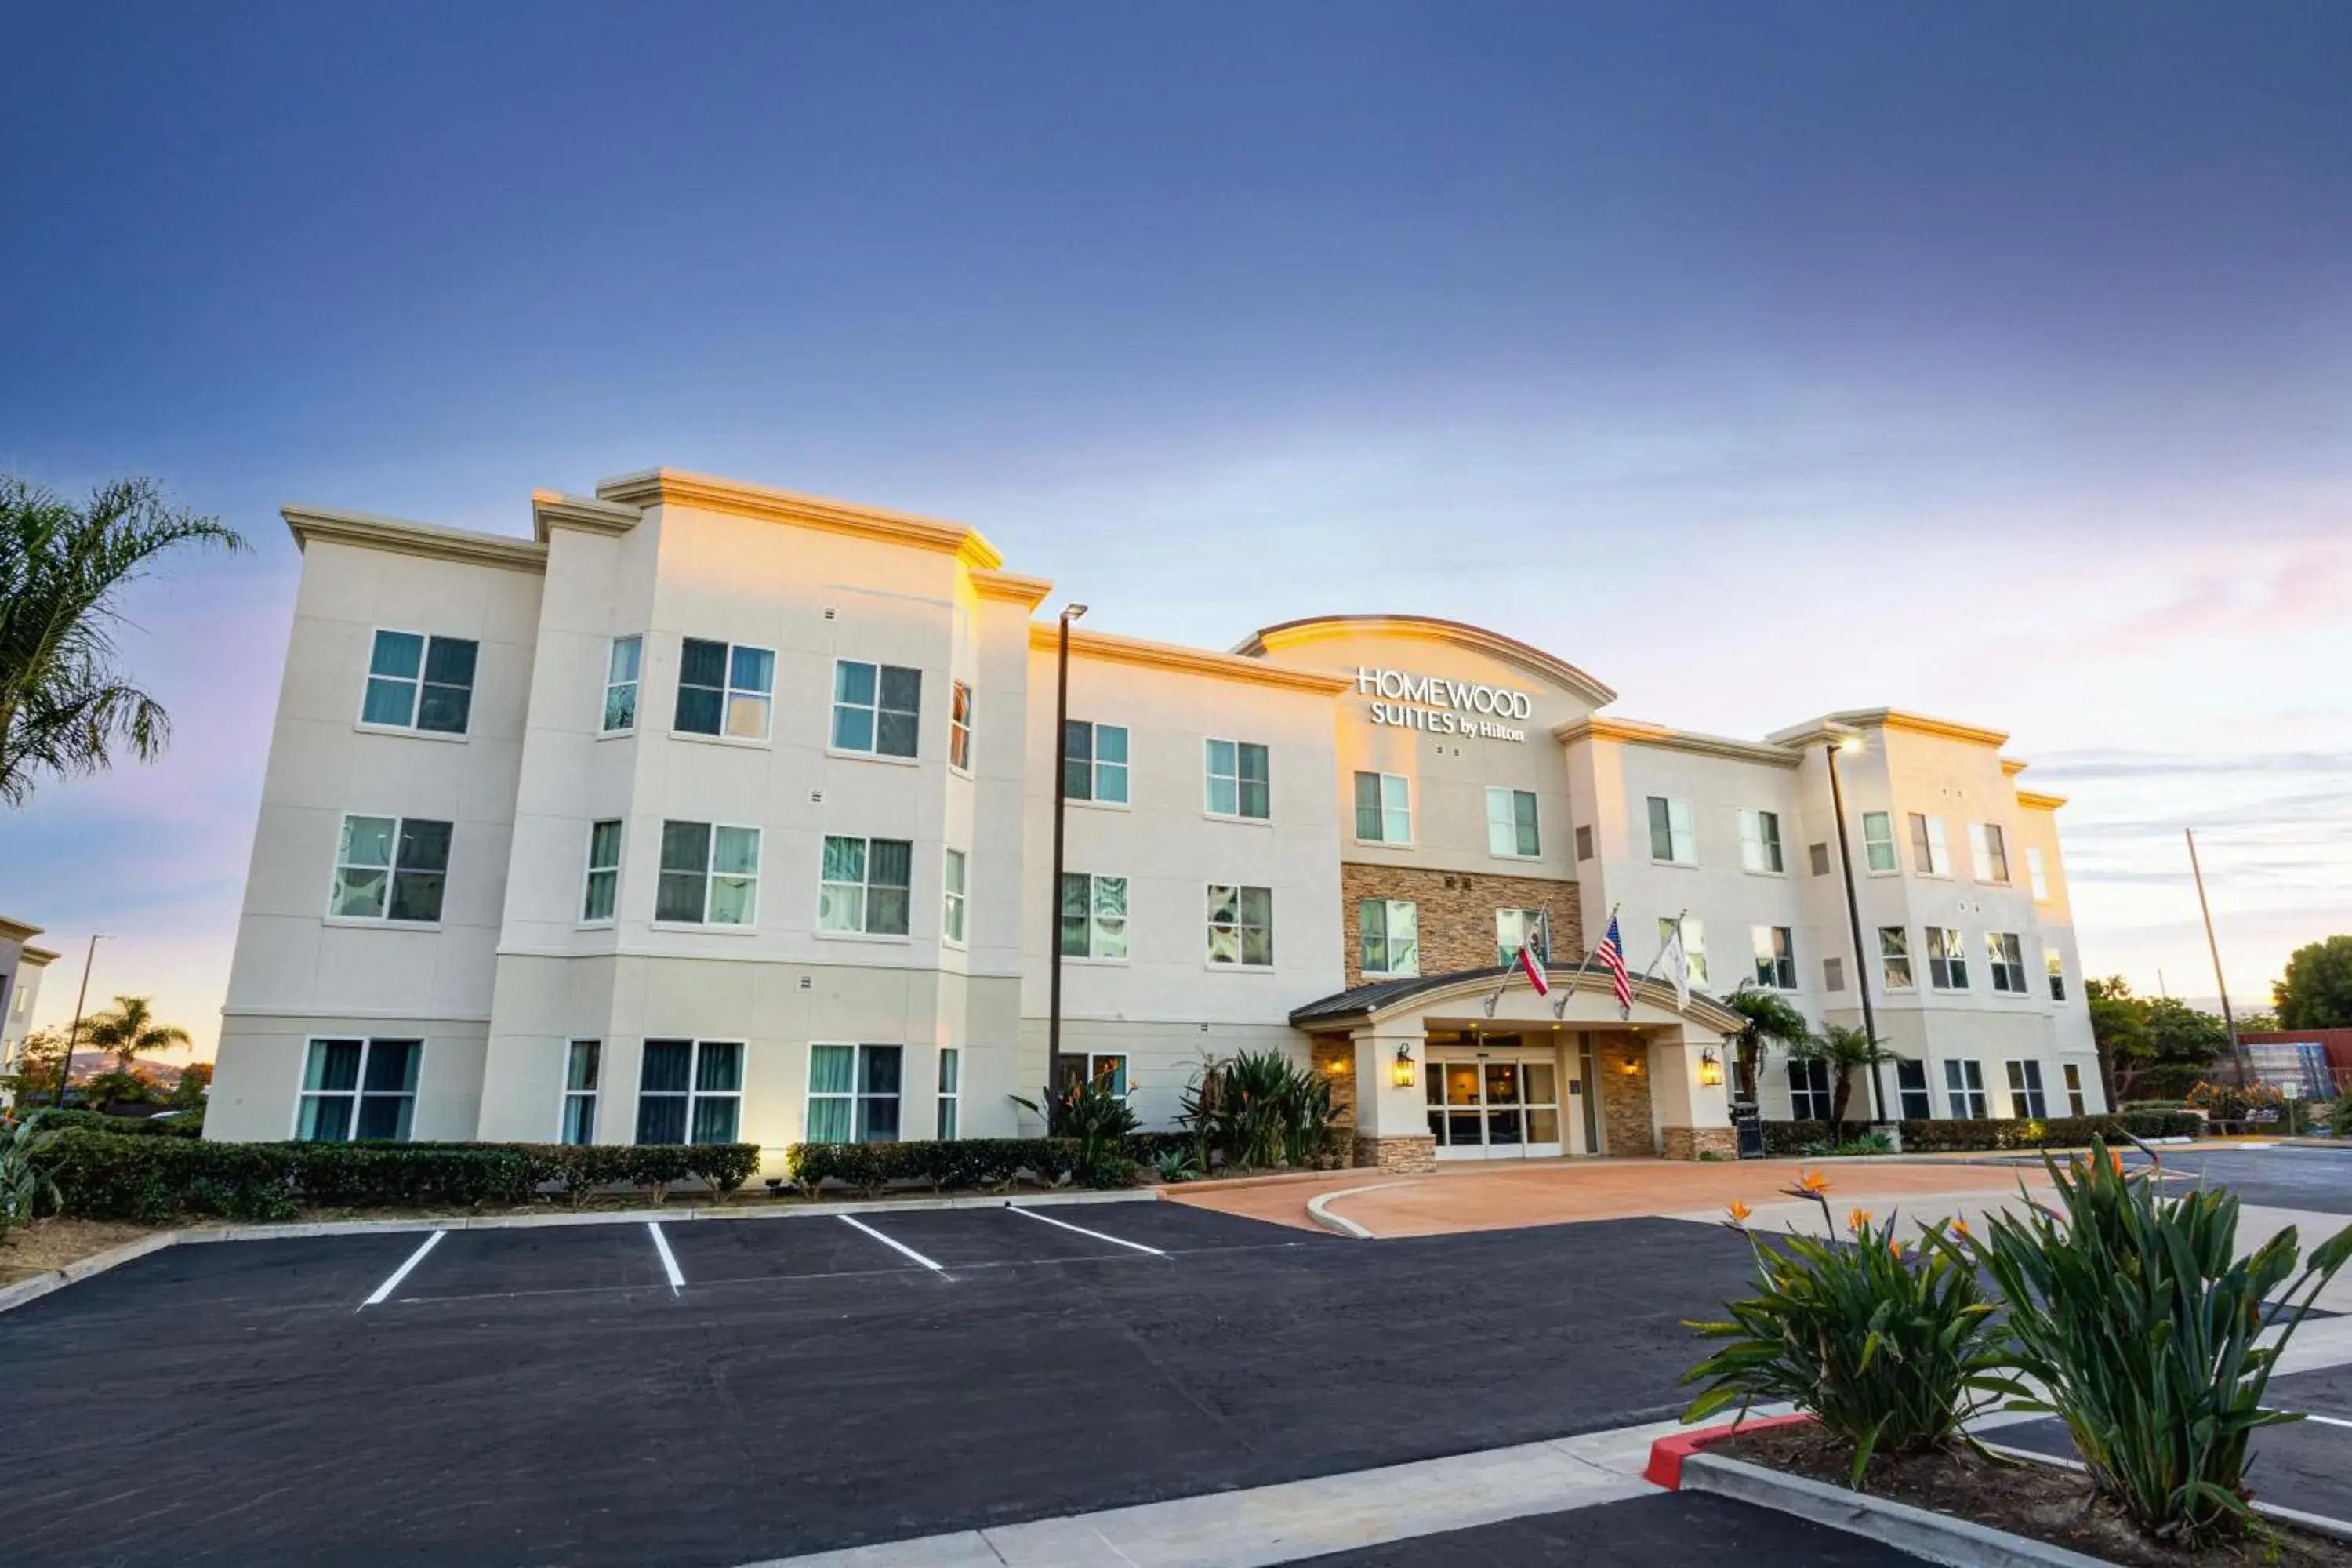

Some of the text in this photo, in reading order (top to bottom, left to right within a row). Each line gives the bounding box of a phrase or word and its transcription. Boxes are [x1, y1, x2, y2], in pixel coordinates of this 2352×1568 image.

[1356, 666, 1530, 719] HOMEWOOD
[1371, 702, 1523, 741] SUITES by Hilton
